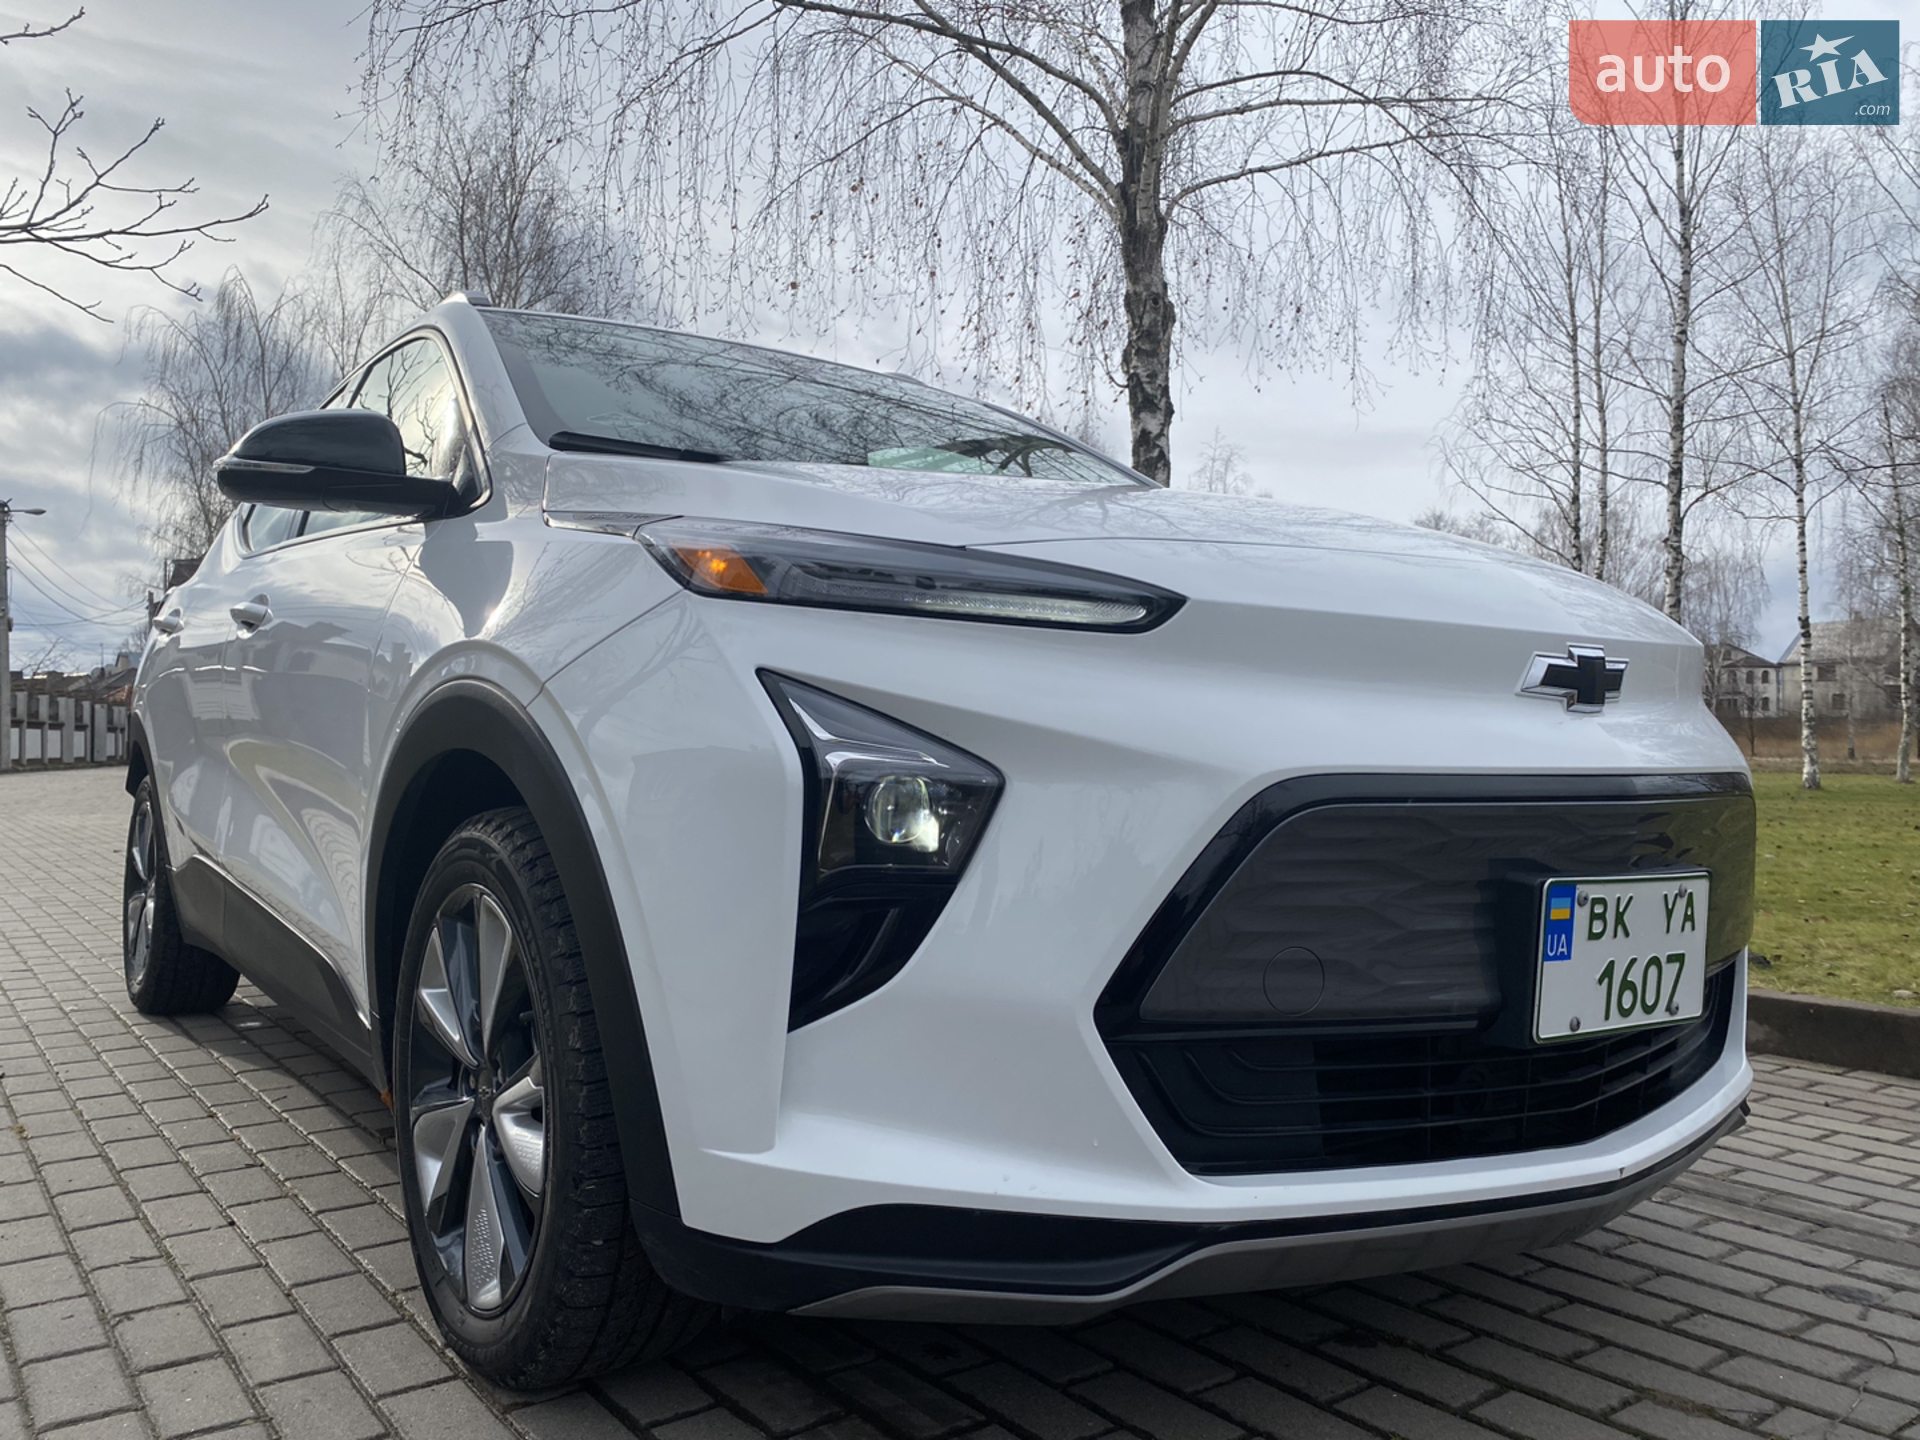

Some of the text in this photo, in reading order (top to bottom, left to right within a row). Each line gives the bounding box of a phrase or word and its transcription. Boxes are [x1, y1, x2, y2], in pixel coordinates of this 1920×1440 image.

[1587, 889, 1696, 941] BK YA
[1547, 933, 1568, 956] UA
[1597, 952, 1686, 1021] 1607
